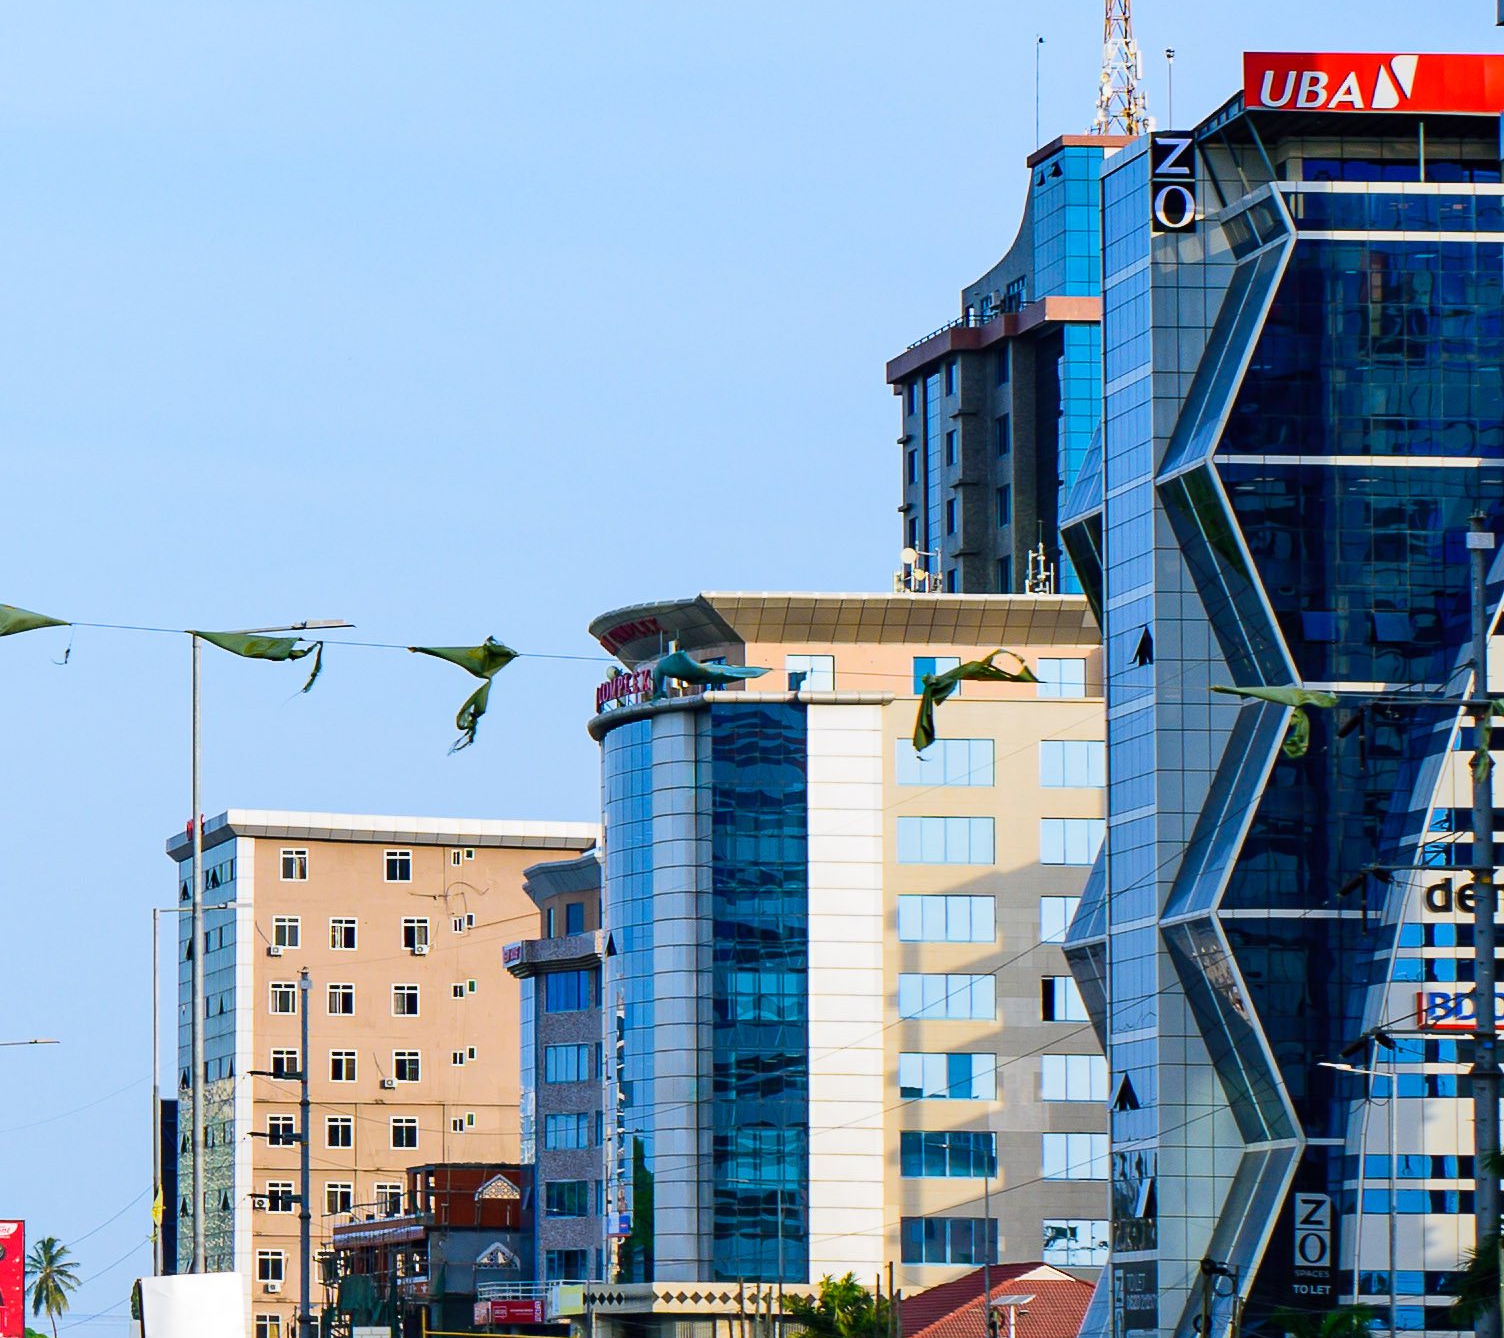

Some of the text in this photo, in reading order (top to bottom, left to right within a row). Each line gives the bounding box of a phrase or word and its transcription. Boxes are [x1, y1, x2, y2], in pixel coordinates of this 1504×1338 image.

[1260, 69, 1365, 110] UBA
[1293, 1284, 1331, 1295] TO LET
